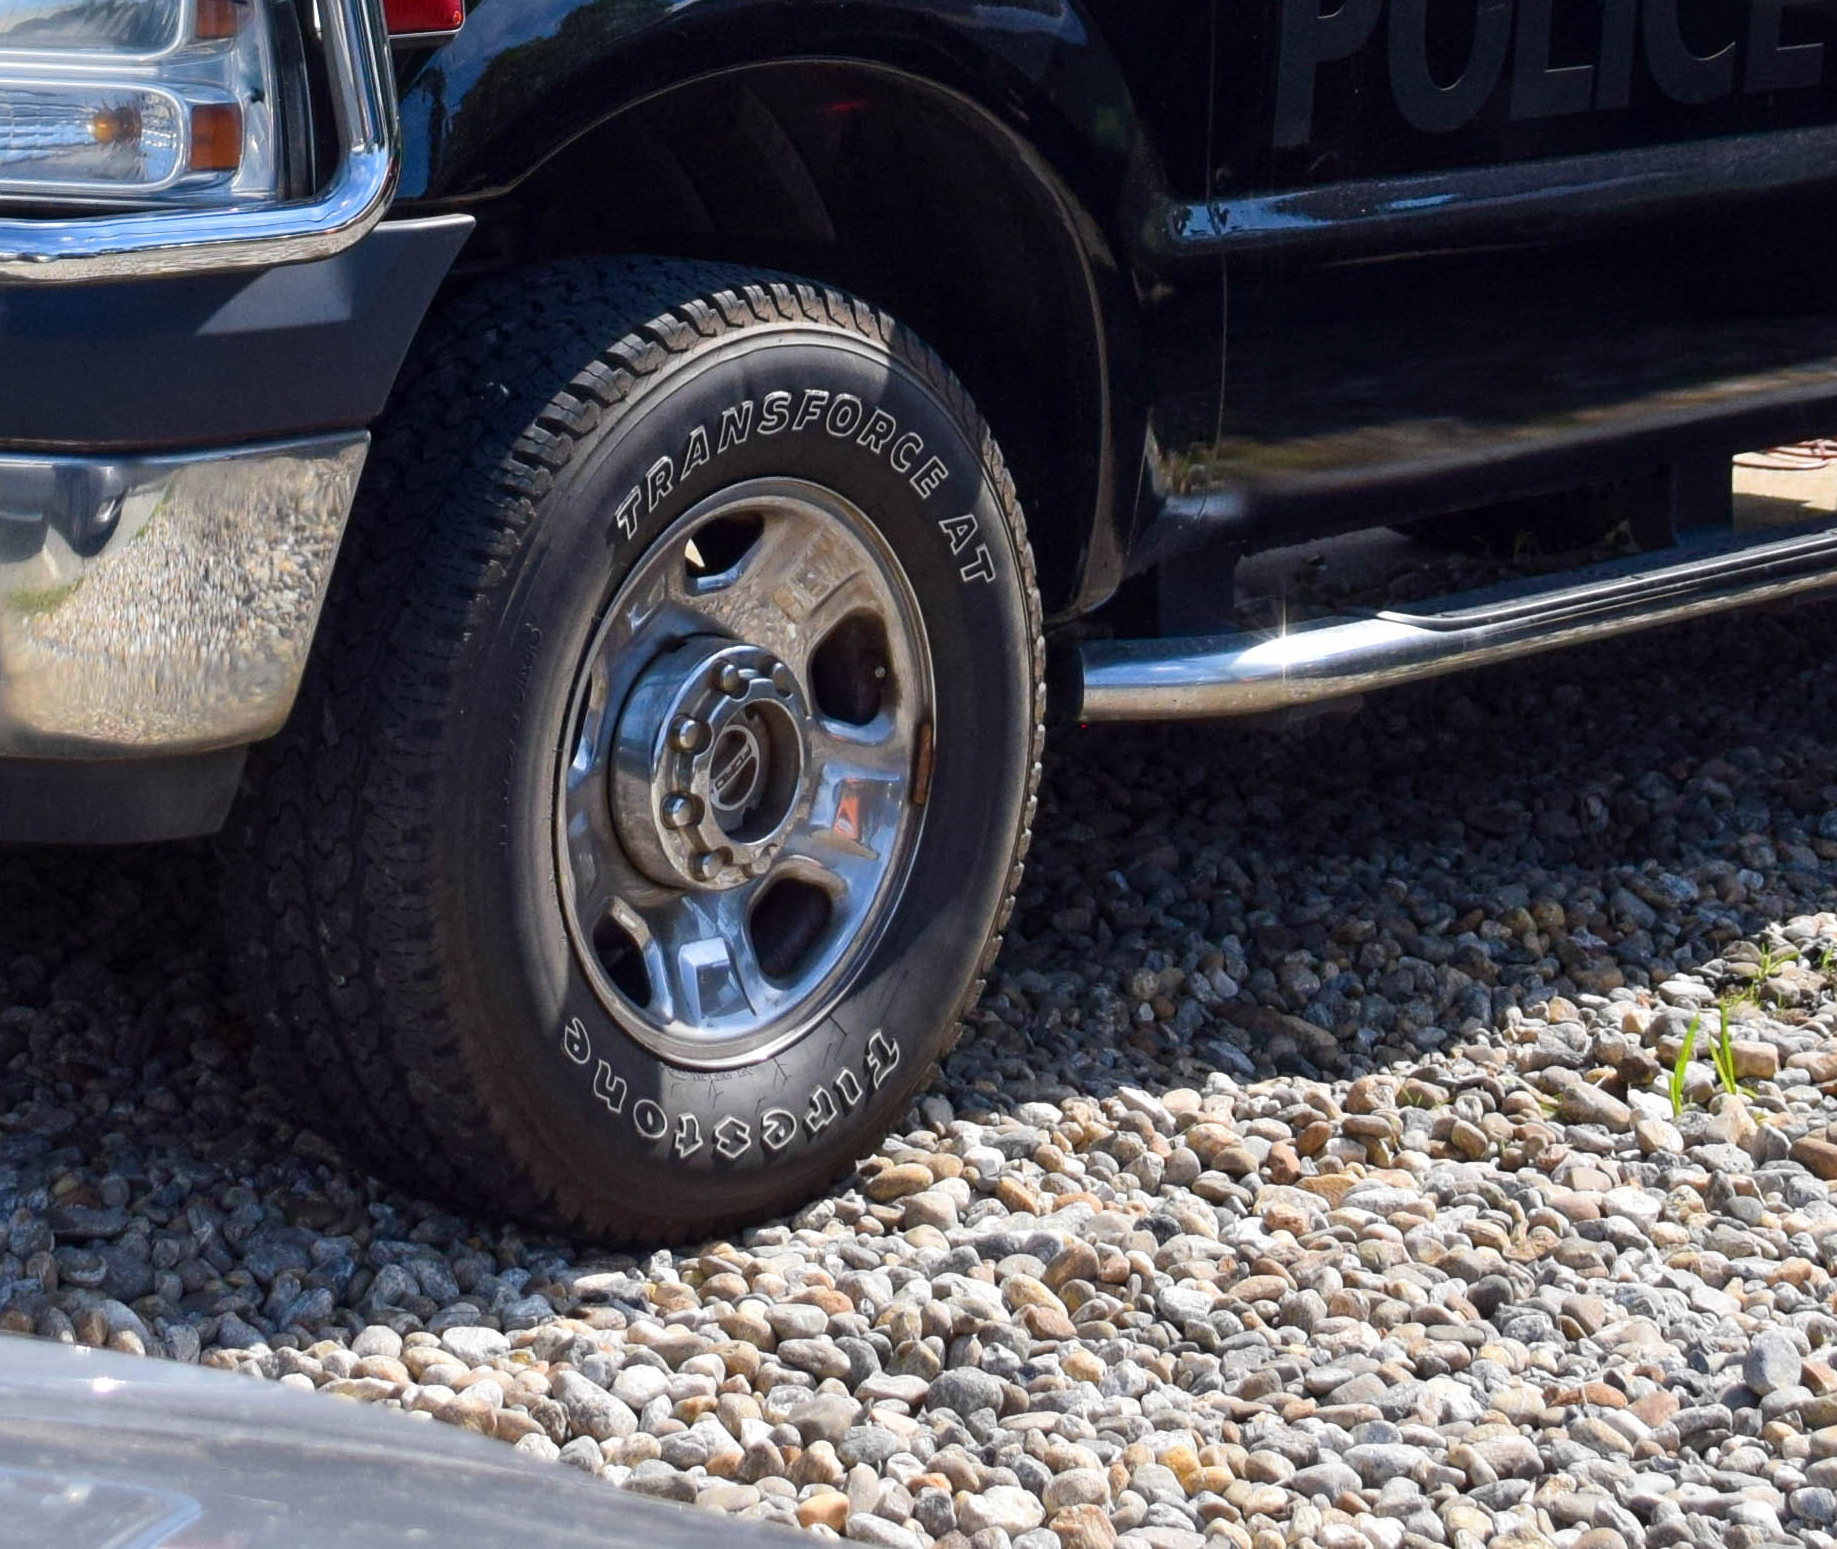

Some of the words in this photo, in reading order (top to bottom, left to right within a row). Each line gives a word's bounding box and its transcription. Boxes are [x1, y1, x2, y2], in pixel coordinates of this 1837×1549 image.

[614, 388, 949, 541] TRANSFORCE
[938, 513, 996, 583] AT
[564, 1017, 900, 1159] Firestone
